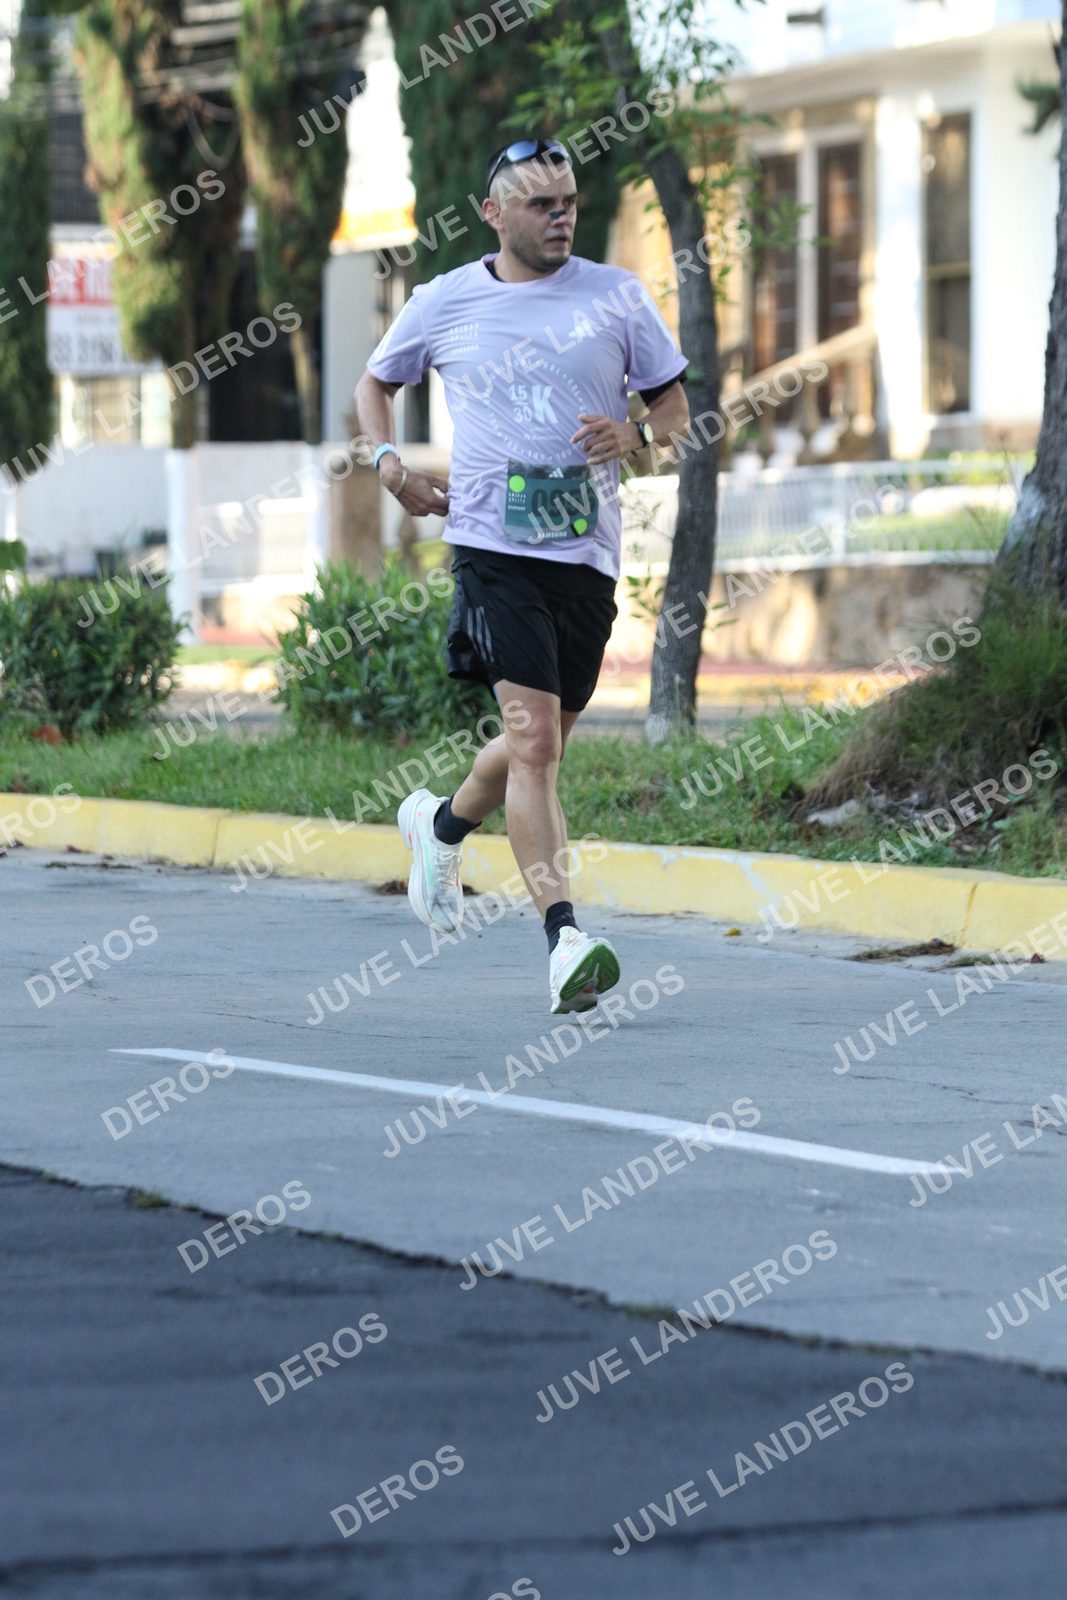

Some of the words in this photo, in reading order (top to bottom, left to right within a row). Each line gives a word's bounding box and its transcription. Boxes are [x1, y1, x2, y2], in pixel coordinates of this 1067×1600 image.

[509, 384, 528, 402] 15
[531, 385, 558, 425] K
[513, 406, 532, 423] 30
